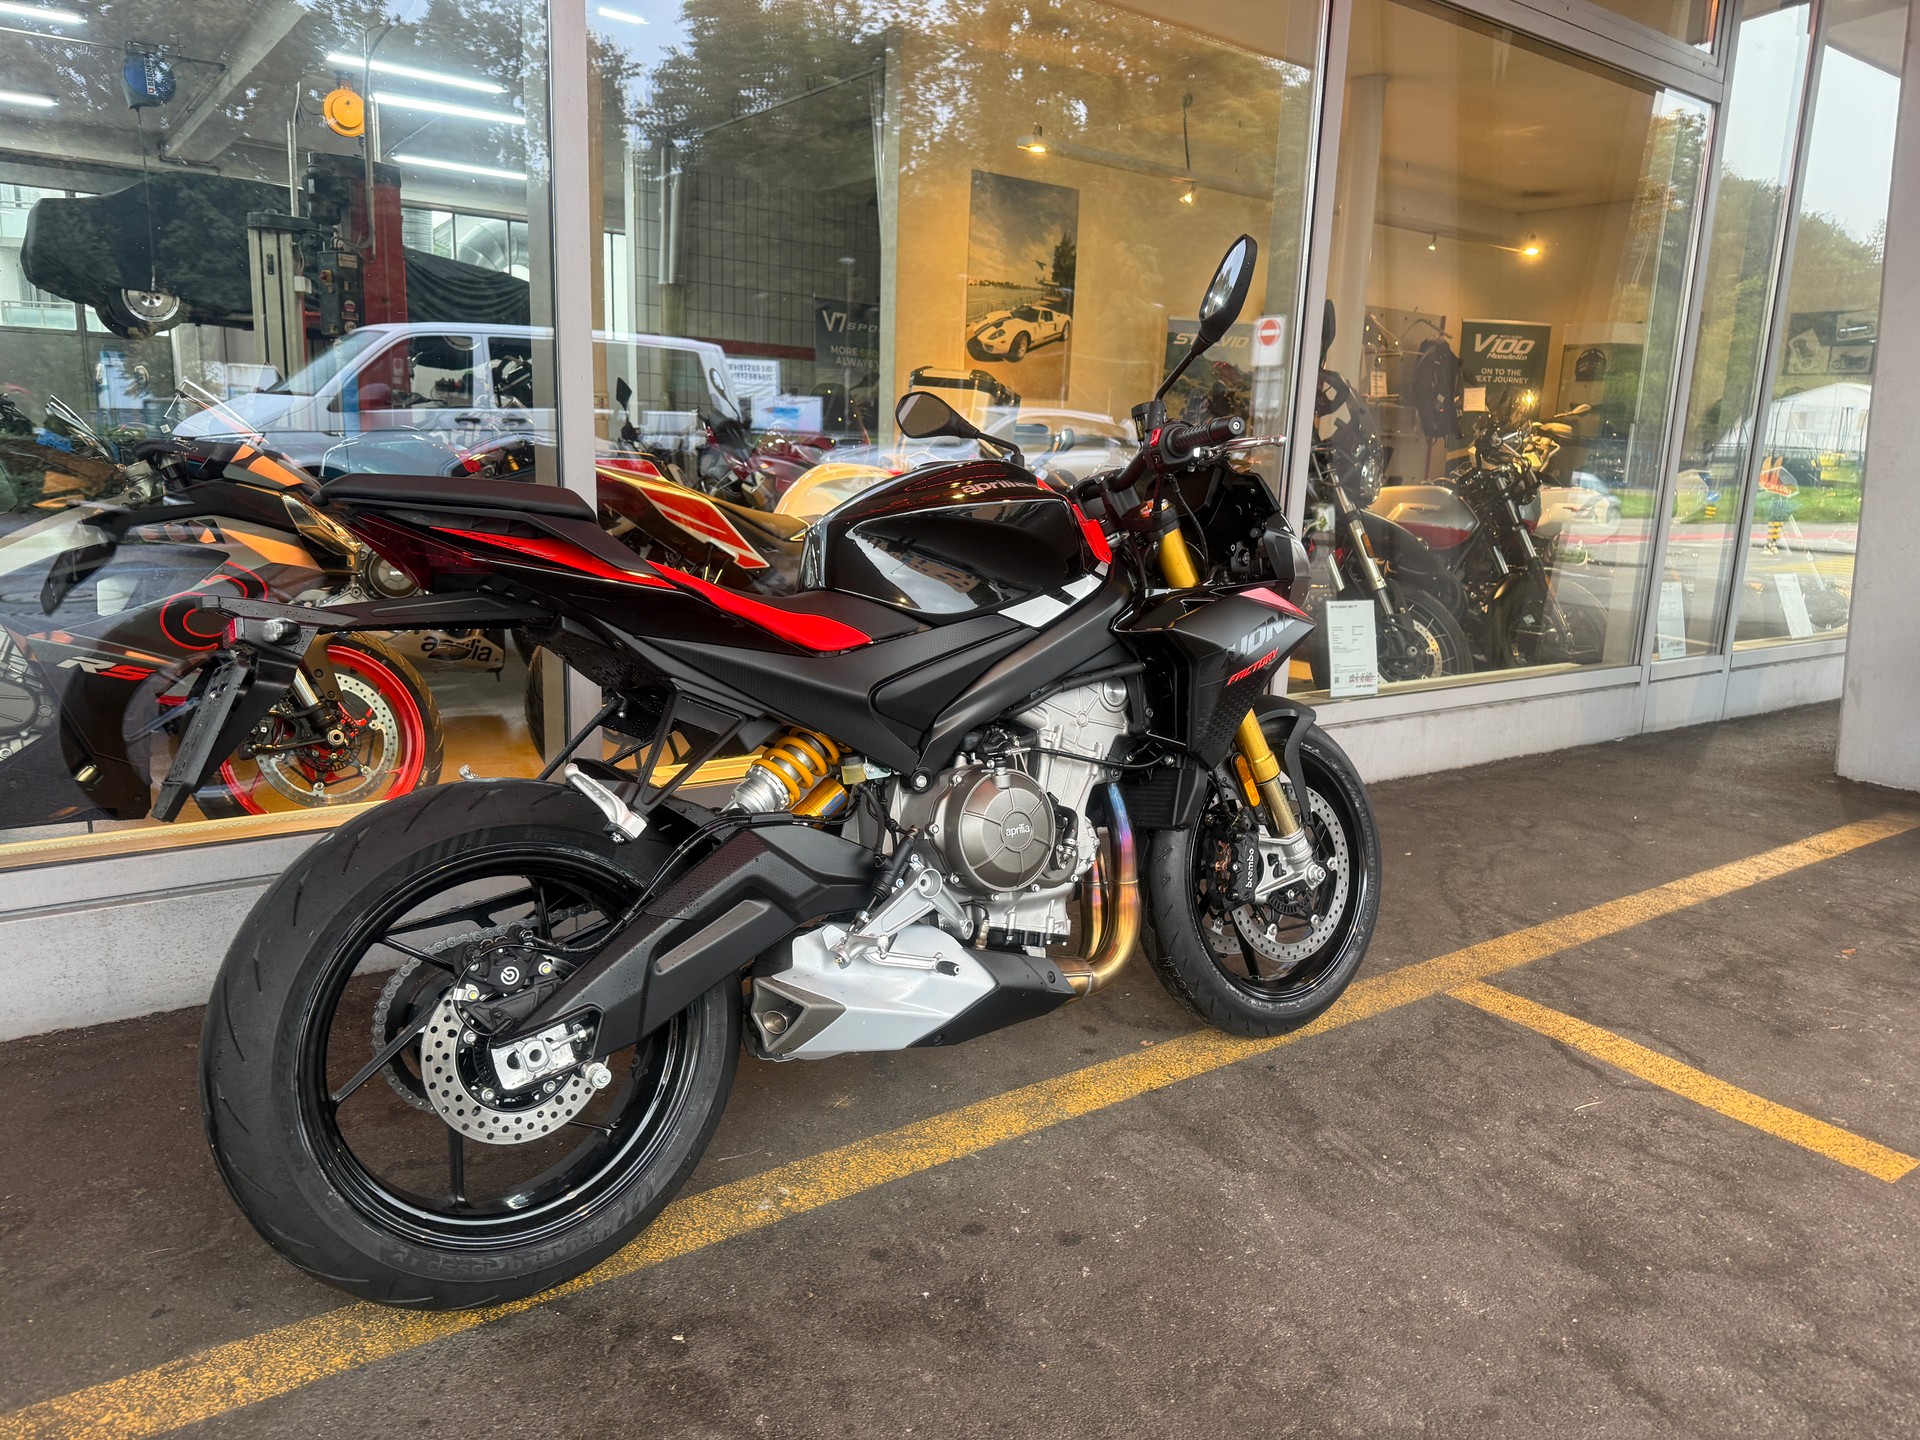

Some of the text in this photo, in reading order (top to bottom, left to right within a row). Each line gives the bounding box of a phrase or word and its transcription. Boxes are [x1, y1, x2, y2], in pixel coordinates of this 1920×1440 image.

[822, 310, 847, 333] V7
[831, 345, 858, 357] MORE
[1474, 333, 1535, 354] V100
[836, 357, 873, 369] ALWAYS
[1507, 368, 1522, 376] THE
[1475, 375, 1529, 384] EXT JOURNEY
[56, 656, 157, 681] RS
[1226, 646, 1279, 686] FACTORY
[1005, 823, 1030, 838] aprilia
[1245, 848, 1255, 889] brembo
